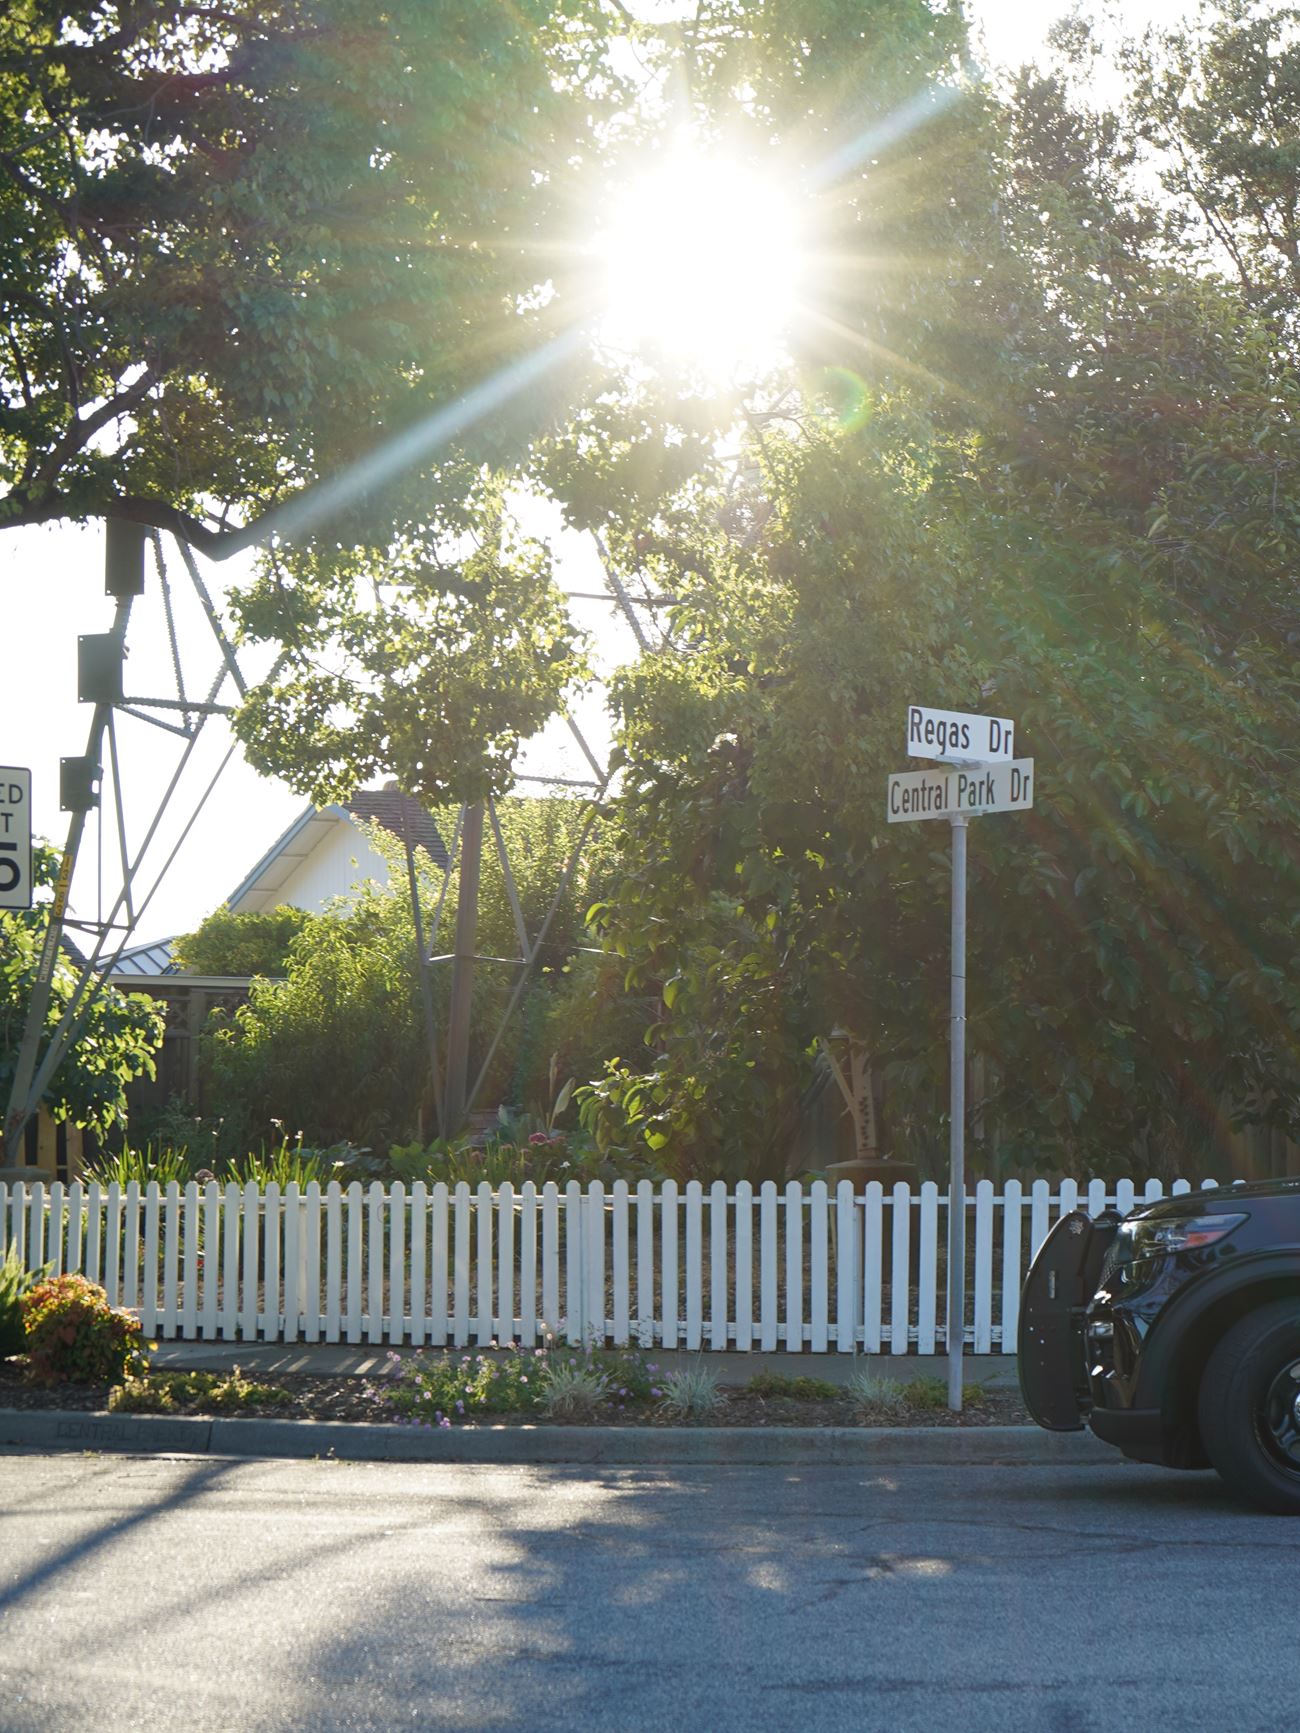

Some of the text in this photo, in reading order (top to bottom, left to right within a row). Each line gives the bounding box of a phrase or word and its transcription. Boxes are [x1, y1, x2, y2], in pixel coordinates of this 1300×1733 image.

[910, 708, 1012, 755] Regas Dr
[891, 768, 1030, 815] Central Park Dr
